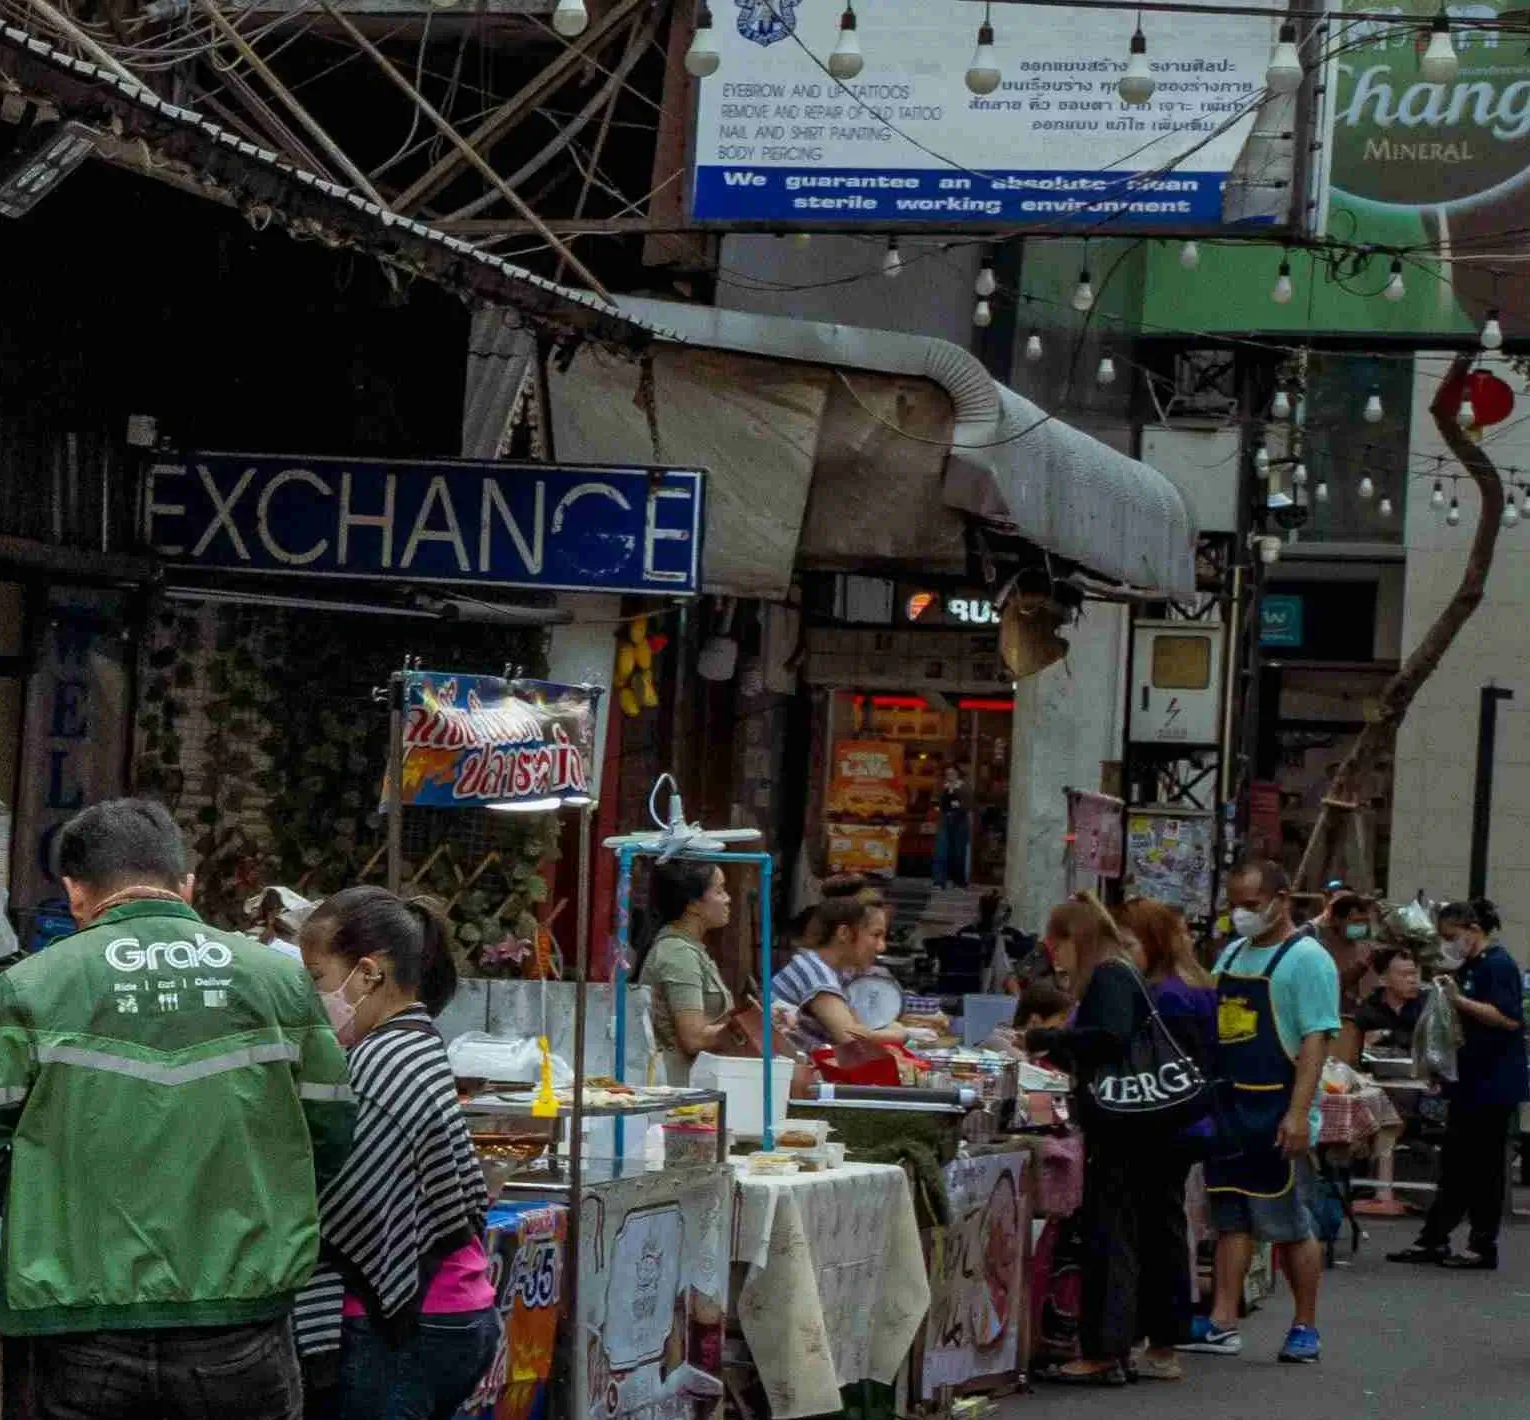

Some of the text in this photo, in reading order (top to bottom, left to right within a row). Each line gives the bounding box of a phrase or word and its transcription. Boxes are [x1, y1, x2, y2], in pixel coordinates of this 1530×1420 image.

[722, 82, 787, 98] EYEBROW
[791, 83, 822, 98] AND
[774, 104, 800, 119] AND
[719, 125, 748, 140] NAIL
[754, 126, 785, 140] AND
[829, 127, 892, 142] PAINTING
[717, 145, 824, 161] BODY PIERCING
[722, 171, 768, 187] We
[785, 175, 921, 190] guarantee
[938, 178, 972, 190] an
[991, 175, 1109, 192] absolute
[793, 195, 1192, 214] sterile working environment
[144, 463, 694, 583] EXCHANGE
[105, 933, 232, 972] Grab
